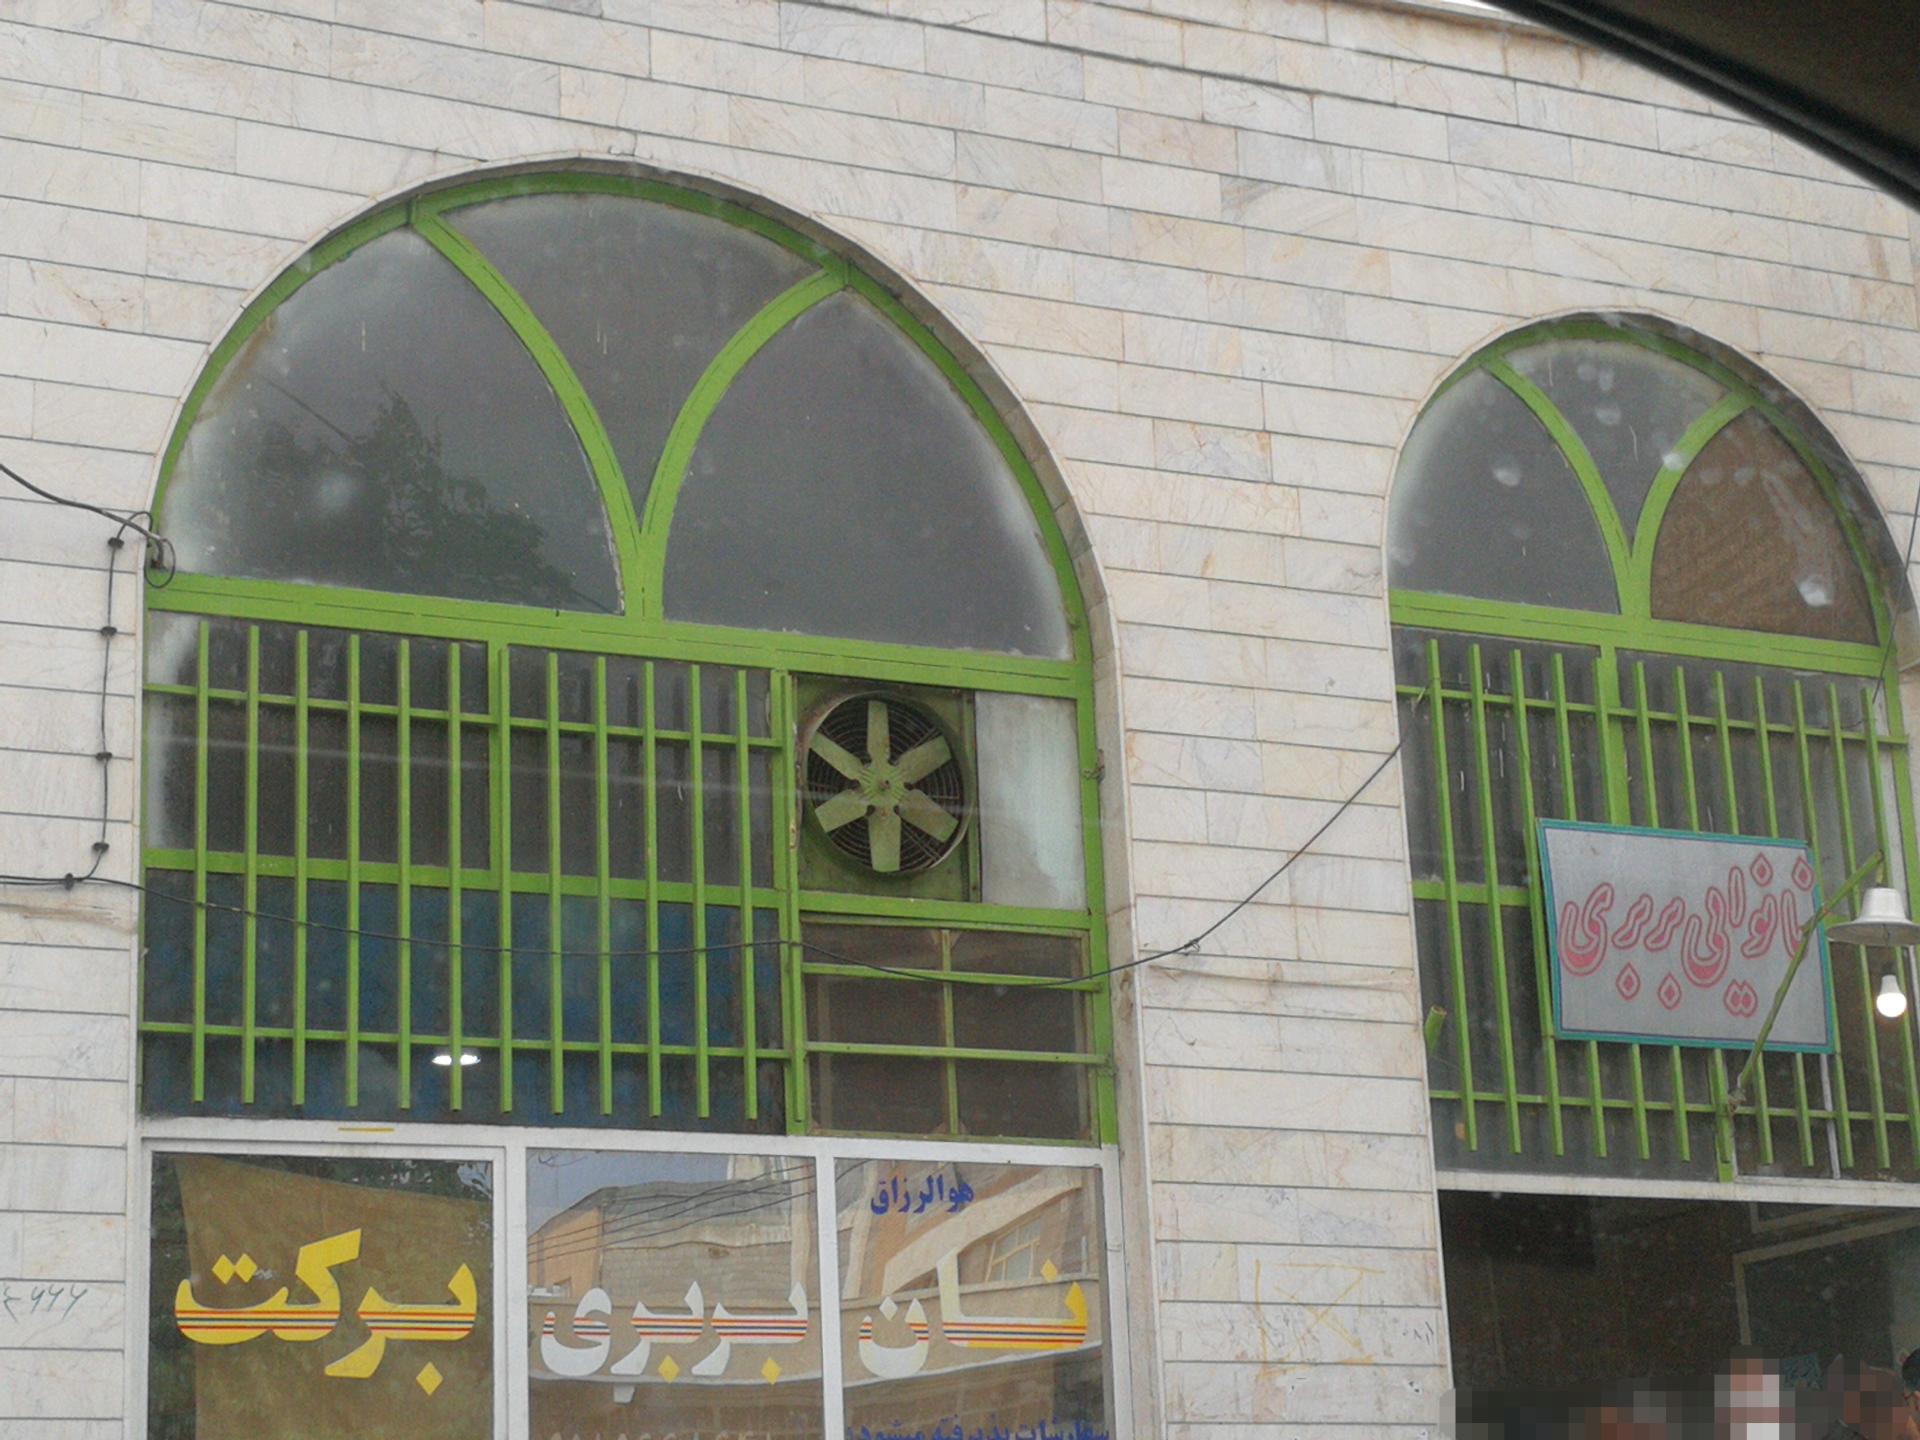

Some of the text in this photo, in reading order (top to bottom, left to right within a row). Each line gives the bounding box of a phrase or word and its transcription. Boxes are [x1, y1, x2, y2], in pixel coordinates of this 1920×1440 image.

[175, 1228, 1087, 1396] نان بربری برکت
